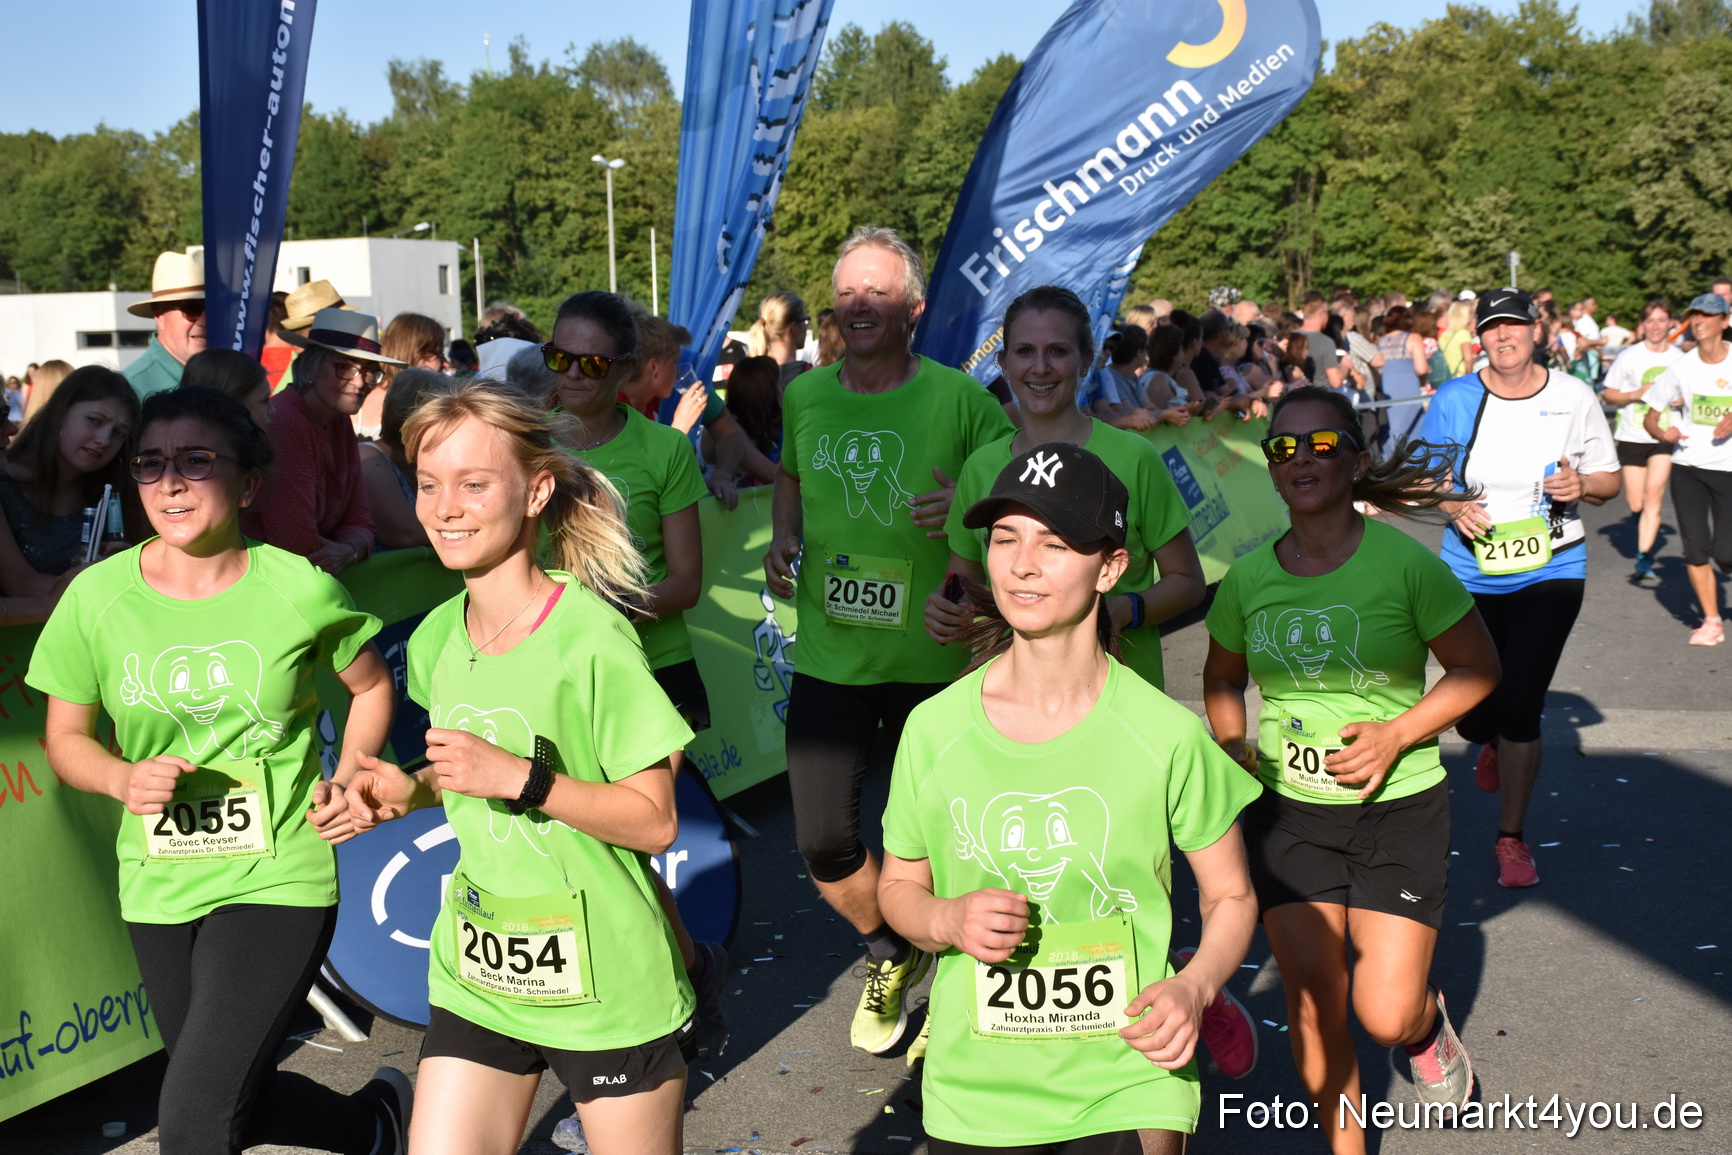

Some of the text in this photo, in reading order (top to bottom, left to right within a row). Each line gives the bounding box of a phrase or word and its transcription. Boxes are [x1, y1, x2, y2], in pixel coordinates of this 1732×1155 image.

[1117, 43, 1296, 196] Druck und Medien
[959, 79, 1204, 297] Frischmann
[1484, 537, 1540, 560] 2120
[828, 577, 896, 609] 2050
[826, 601, 899, 618] Dr. Schmiedel Michael
[1298, 773, 1319, 784] Mutlu
[153, 797, 251, 836] 2055
[158, 847, 205, 856] Zahnarztpraxis
[217, 843, 254, 851] Schmiedel
[168, 836, 238, 847] Gövec Kevser
[501, 922, 529, 932] 2018
[463, 921, 566, 974] 2054
[1048, 951, 1080, 963] 2018
[467, 972, 512, 994] Zahnarztpraxis
[513, 986, 525, 995] Dr.
[526, 986, 569, 996] Schmiedel
[480, 967, 504, 983] Beck
[506, 975, 546, 988] Marina
[986, 964, 1114, 1011] 2056
[990, 1021, 1116, 1035] Zahnarztpraxis Dr. Schmiedel
[1004, 1011, 1101, 1024] Hoxha Miranda
